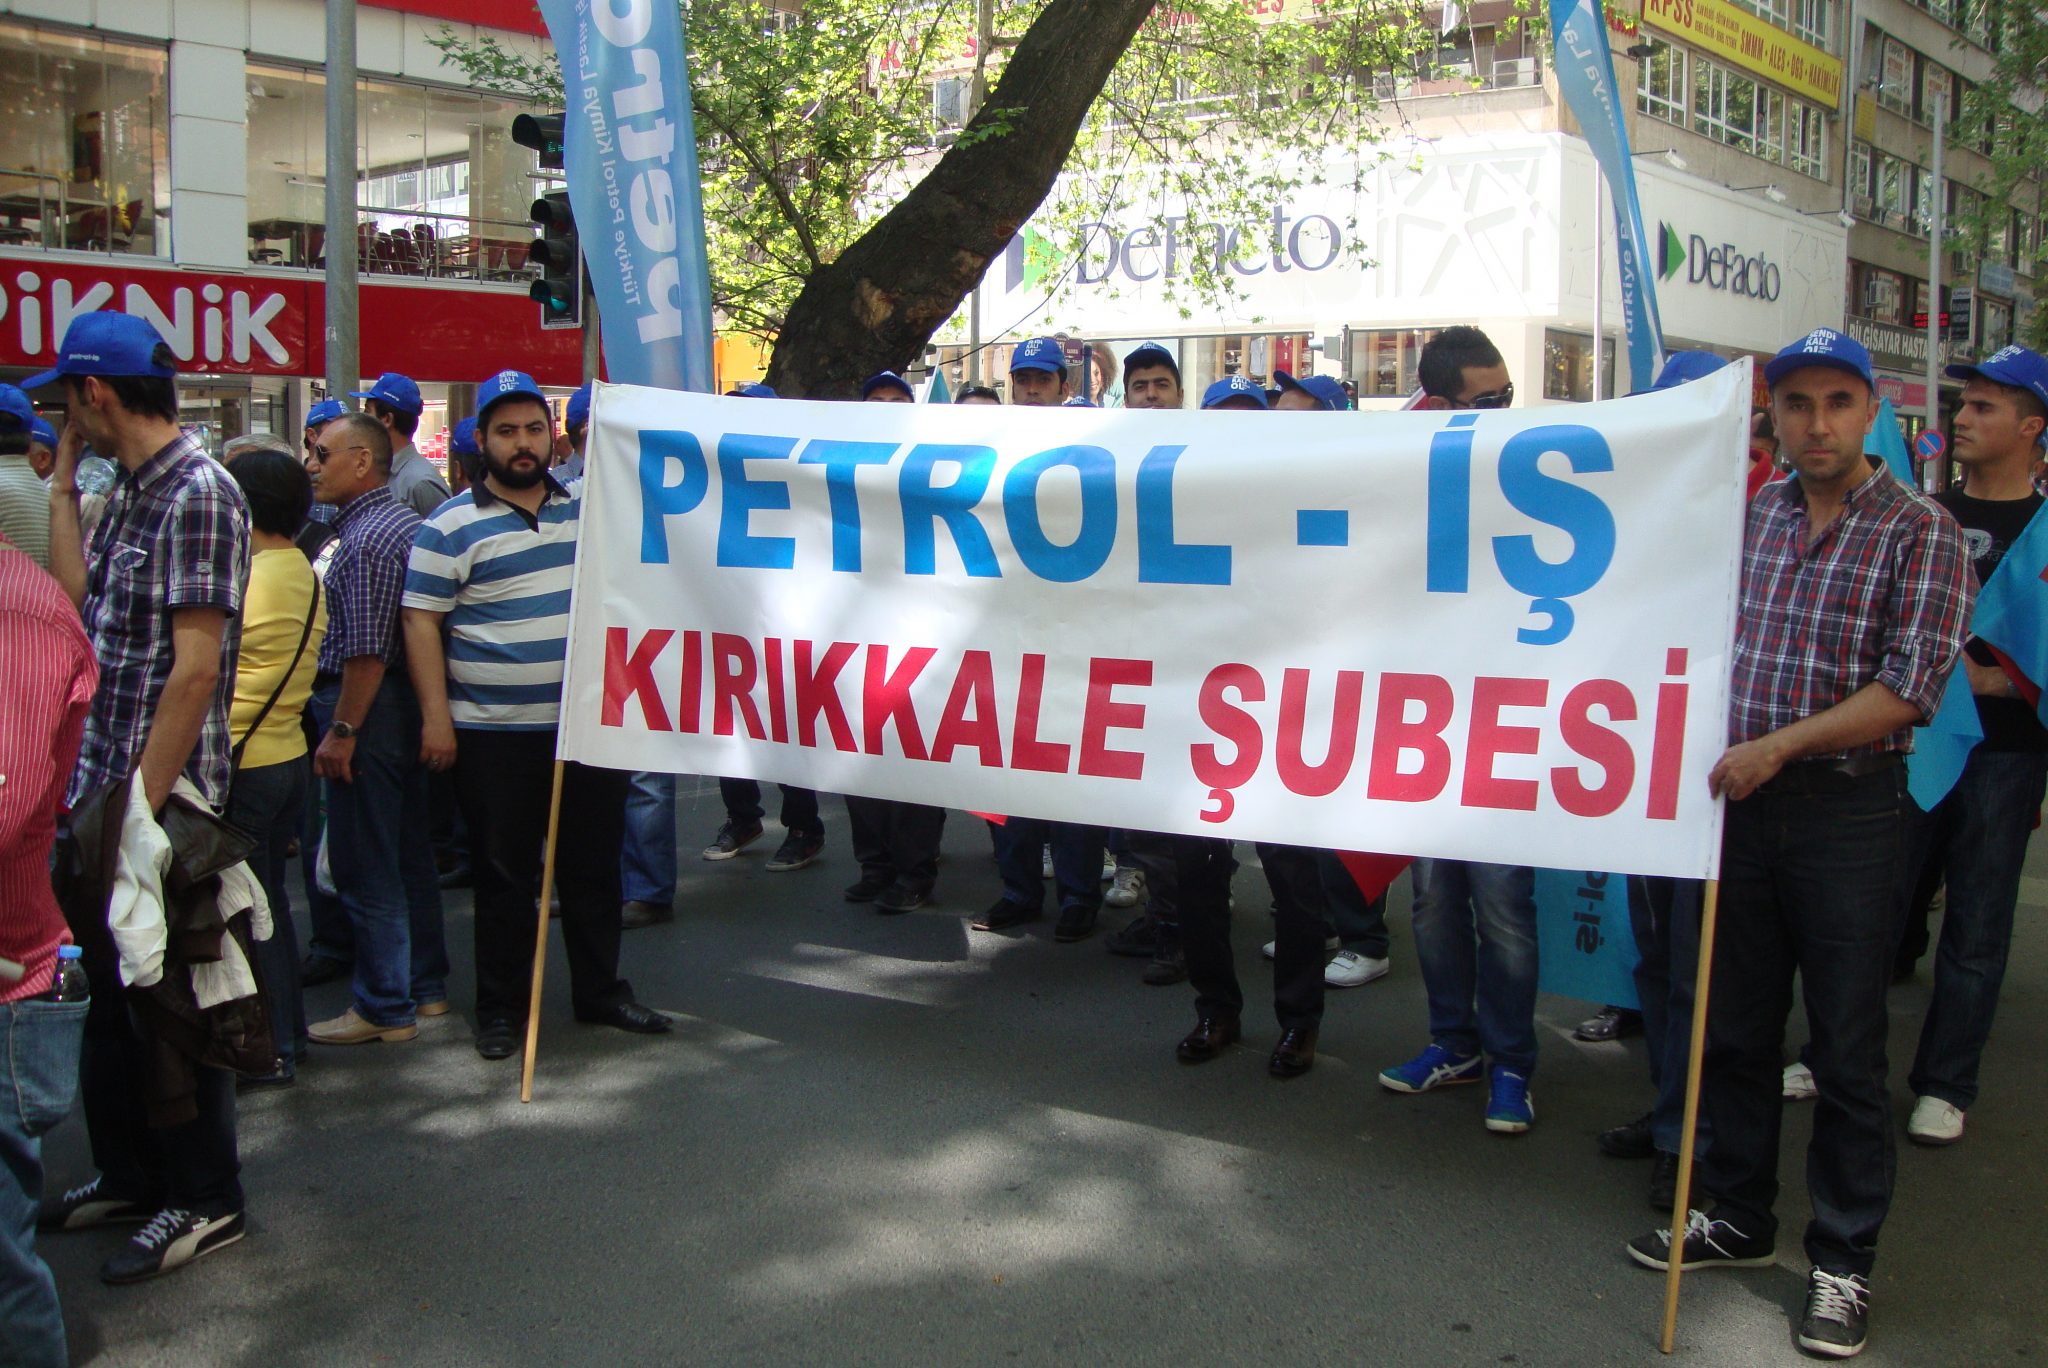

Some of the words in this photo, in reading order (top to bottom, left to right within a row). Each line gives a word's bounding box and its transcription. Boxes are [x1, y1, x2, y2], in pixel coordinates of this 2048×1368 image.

[1769, 43, 1786, 73] ALES
[1075, 204, 1342, 285] DeFacto
[1688, 233, 1781, 302] DeFacto
[1902, 334, 1947, 364] HASTASİ
[638, 429, 1232, 586] PETROL
[1426, 413, 1617, 646] İŞ
[600, 626, 1154, 781] KIRIKKALE
[1190, 646, 1690, 824] ŞUBESİ
